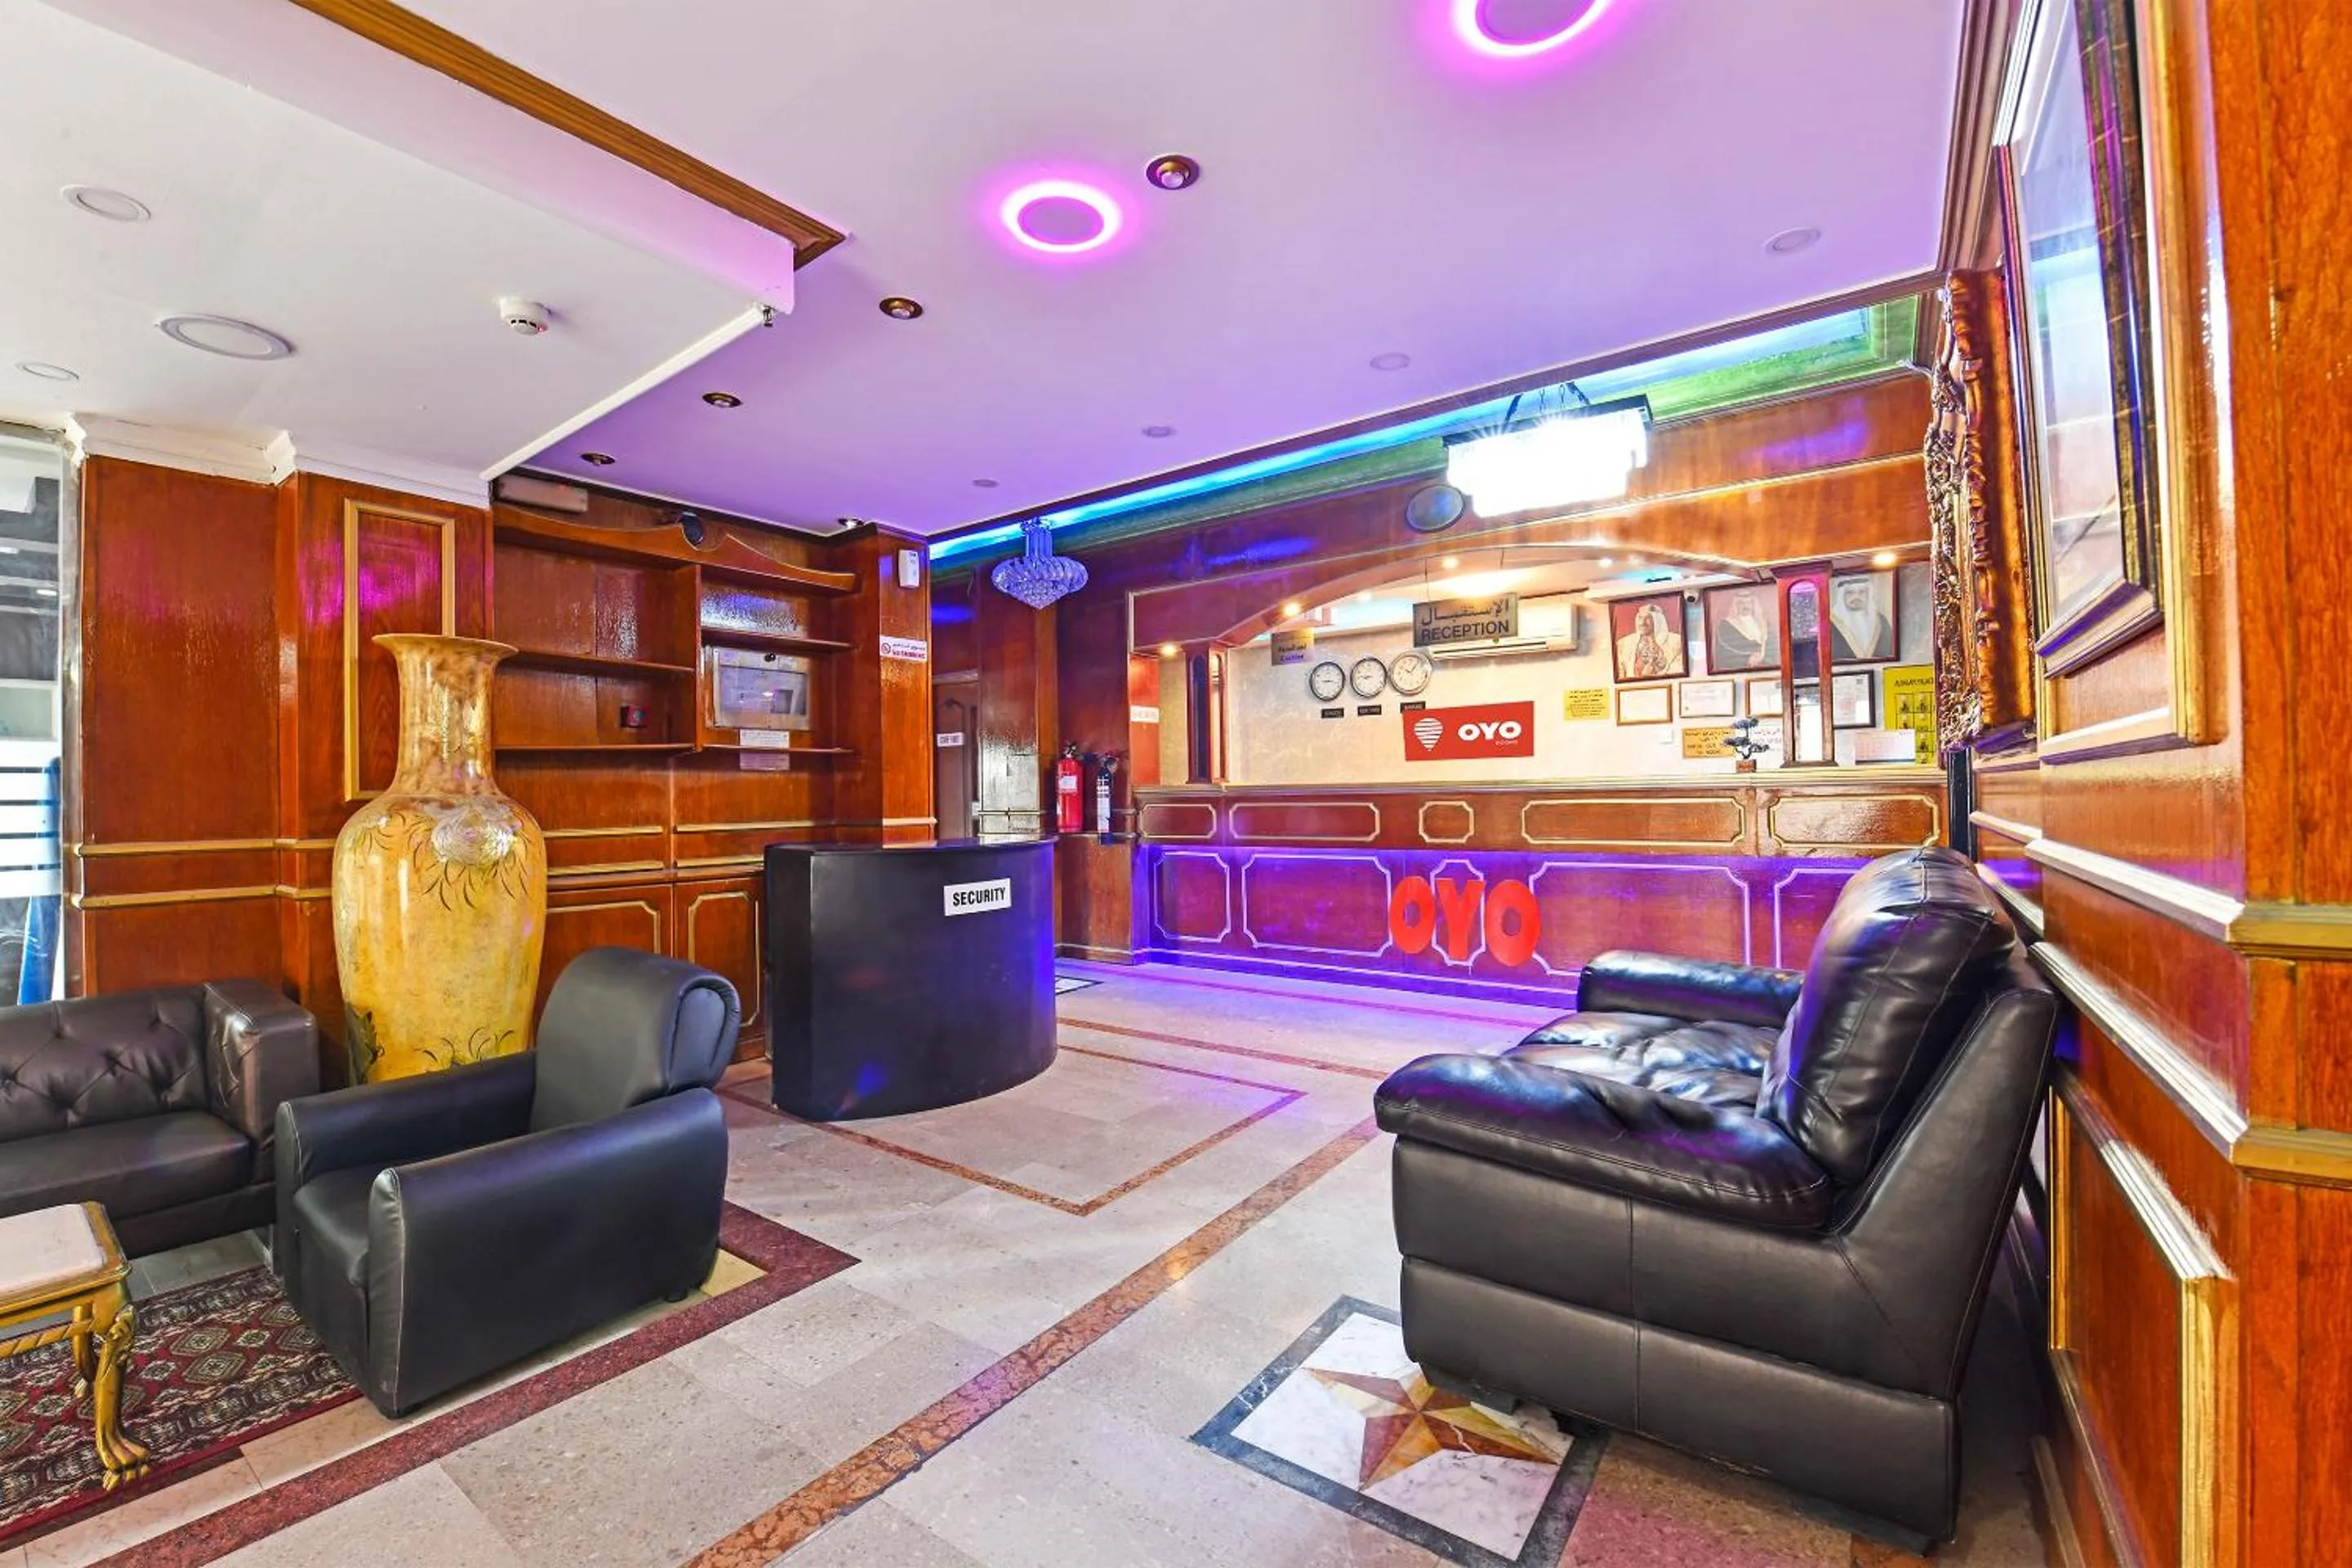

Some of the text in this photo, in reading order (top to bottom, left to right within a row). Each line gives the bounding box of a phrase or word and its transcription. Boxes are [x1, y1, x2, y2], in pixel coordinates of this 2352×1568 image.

[1421, 619, 1510, 641] RECEPTION
[1458, 720, 1522, 742] OYO
[952, 887, 1006, 906] SECURITY
[1389, 875, 1540, 967] OYO
